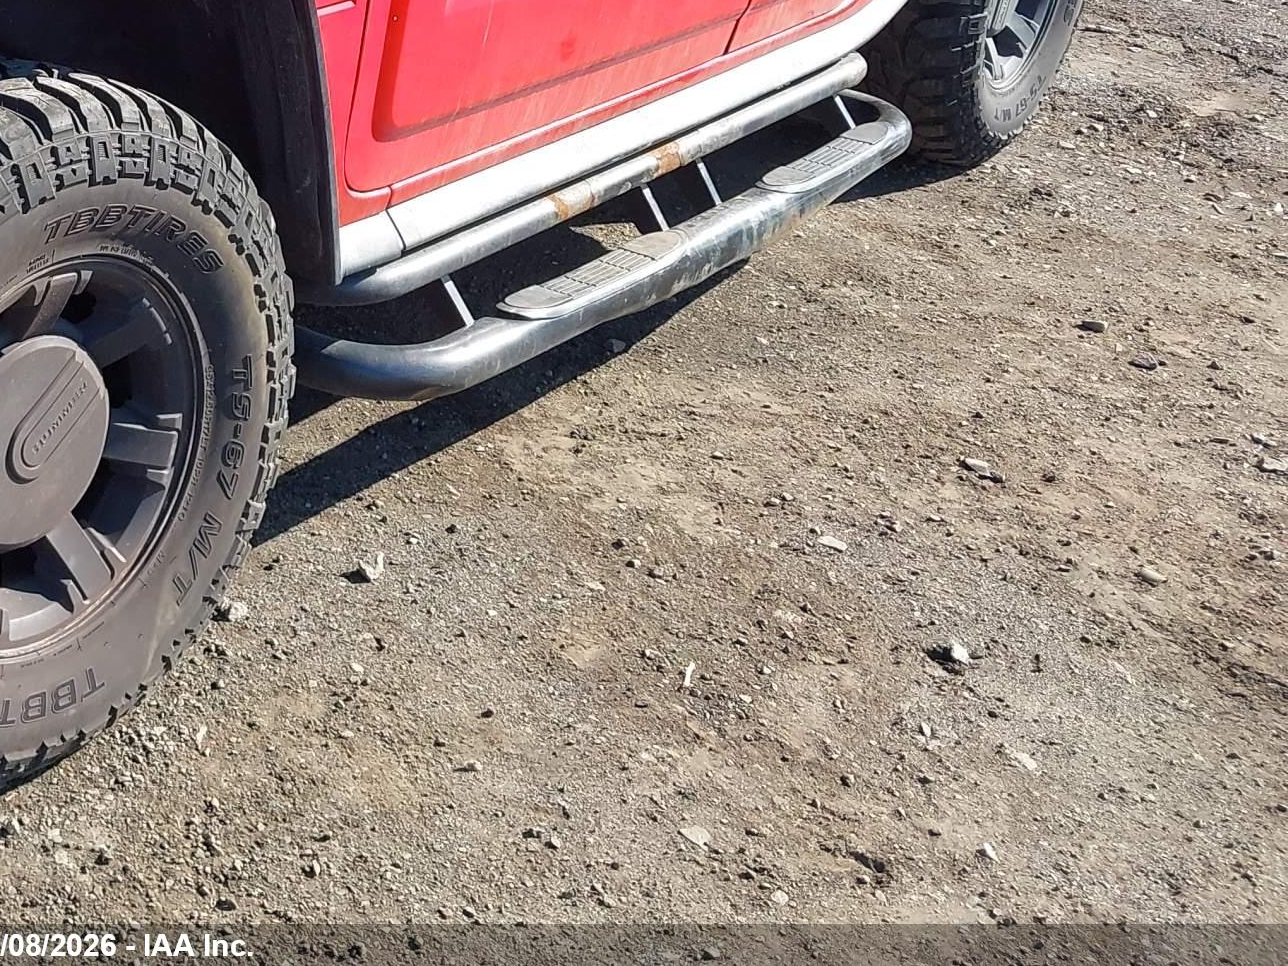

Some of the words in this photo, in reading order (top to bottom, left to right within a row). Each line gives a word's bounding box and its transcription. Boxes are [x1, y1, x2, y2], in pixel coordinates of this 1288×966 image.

[43, 203, 225, 274] TBBTIRES
[216, 354, 252, 501] TS-67
[170, 511, 224, 607] M/T
